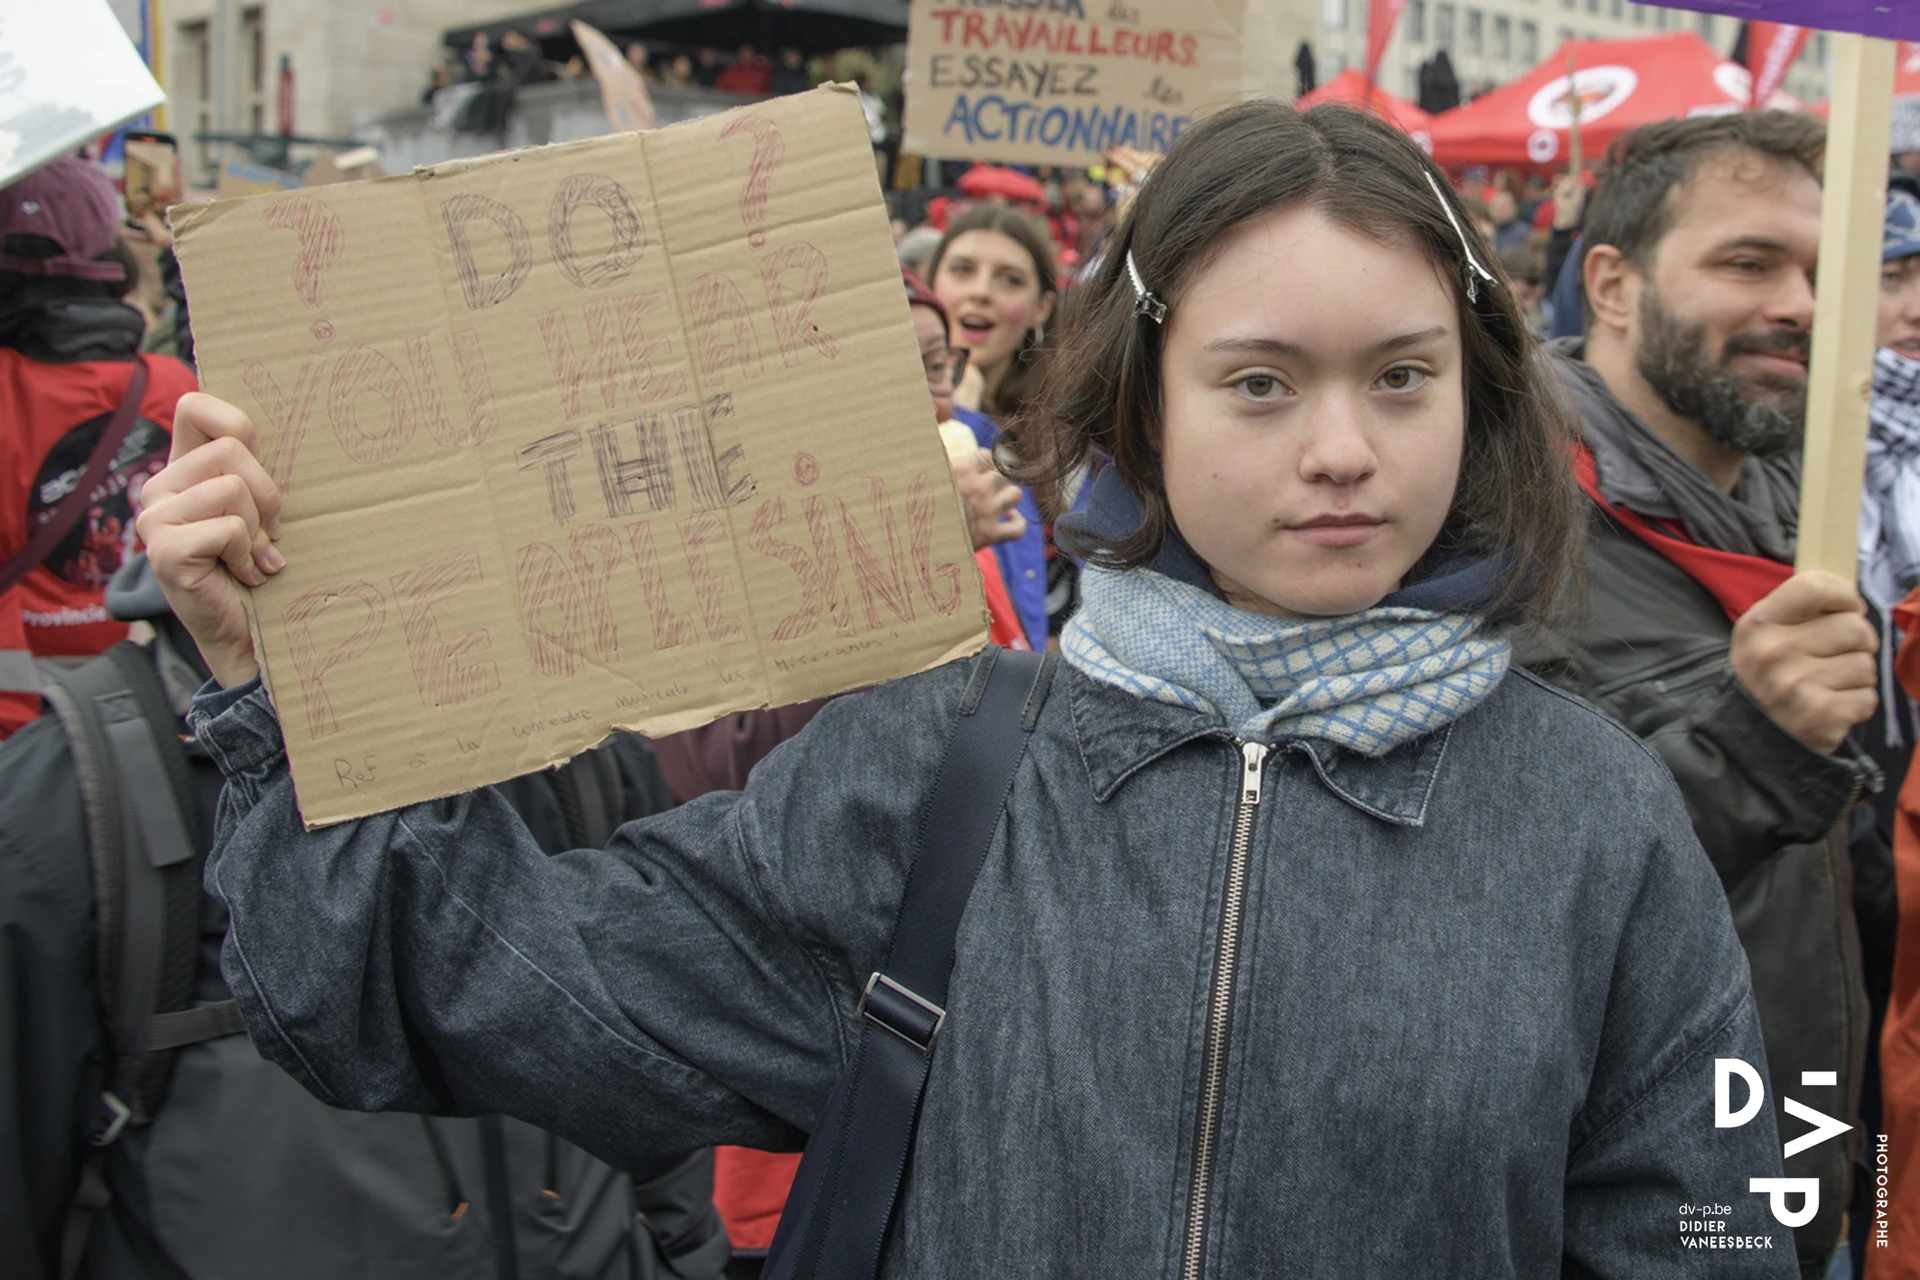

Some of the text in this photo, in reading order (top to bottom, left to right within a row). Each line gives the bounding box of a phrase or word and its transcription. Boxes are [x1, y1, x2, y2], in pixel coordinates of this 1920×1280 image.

[930, 54, 1099, 99] ESSAYEZ
[441, 172, 647, 311] DO
[240, 241, 843, 496] YOU HEAR
[514, 392, 758, 527] THE
